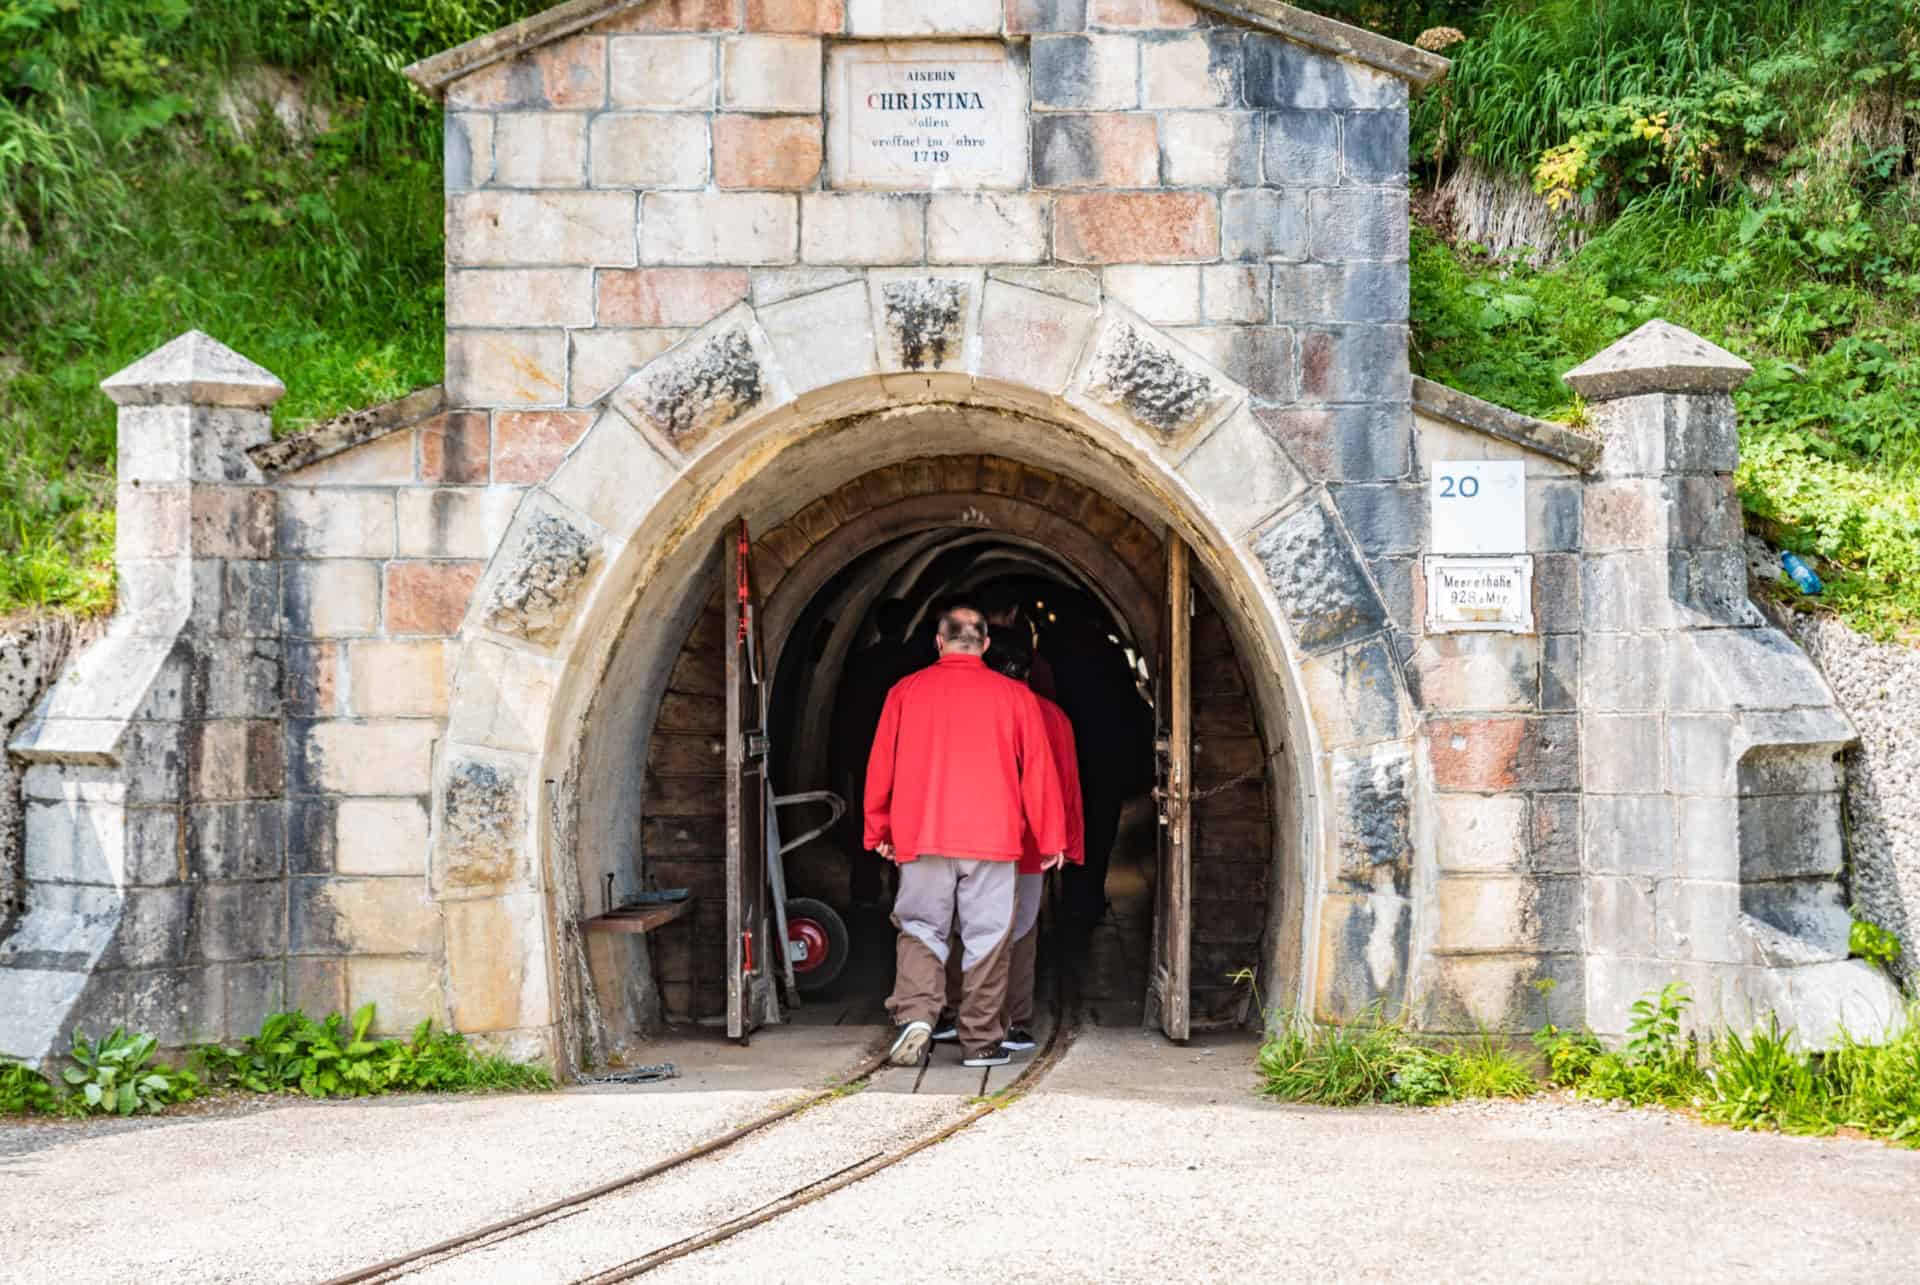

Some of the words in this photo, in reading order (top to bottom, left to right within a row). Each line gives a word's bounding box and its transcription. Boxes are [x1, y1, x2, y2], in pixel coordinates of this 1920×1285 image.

[867, 92, 985, 110] CHRISTINA
[908, 116, 950, 128] ollen
[953, 133, 985, 147] ahre
[913, 151, 949, 163] 1719
[1439, 475, 1479, 498] 20
